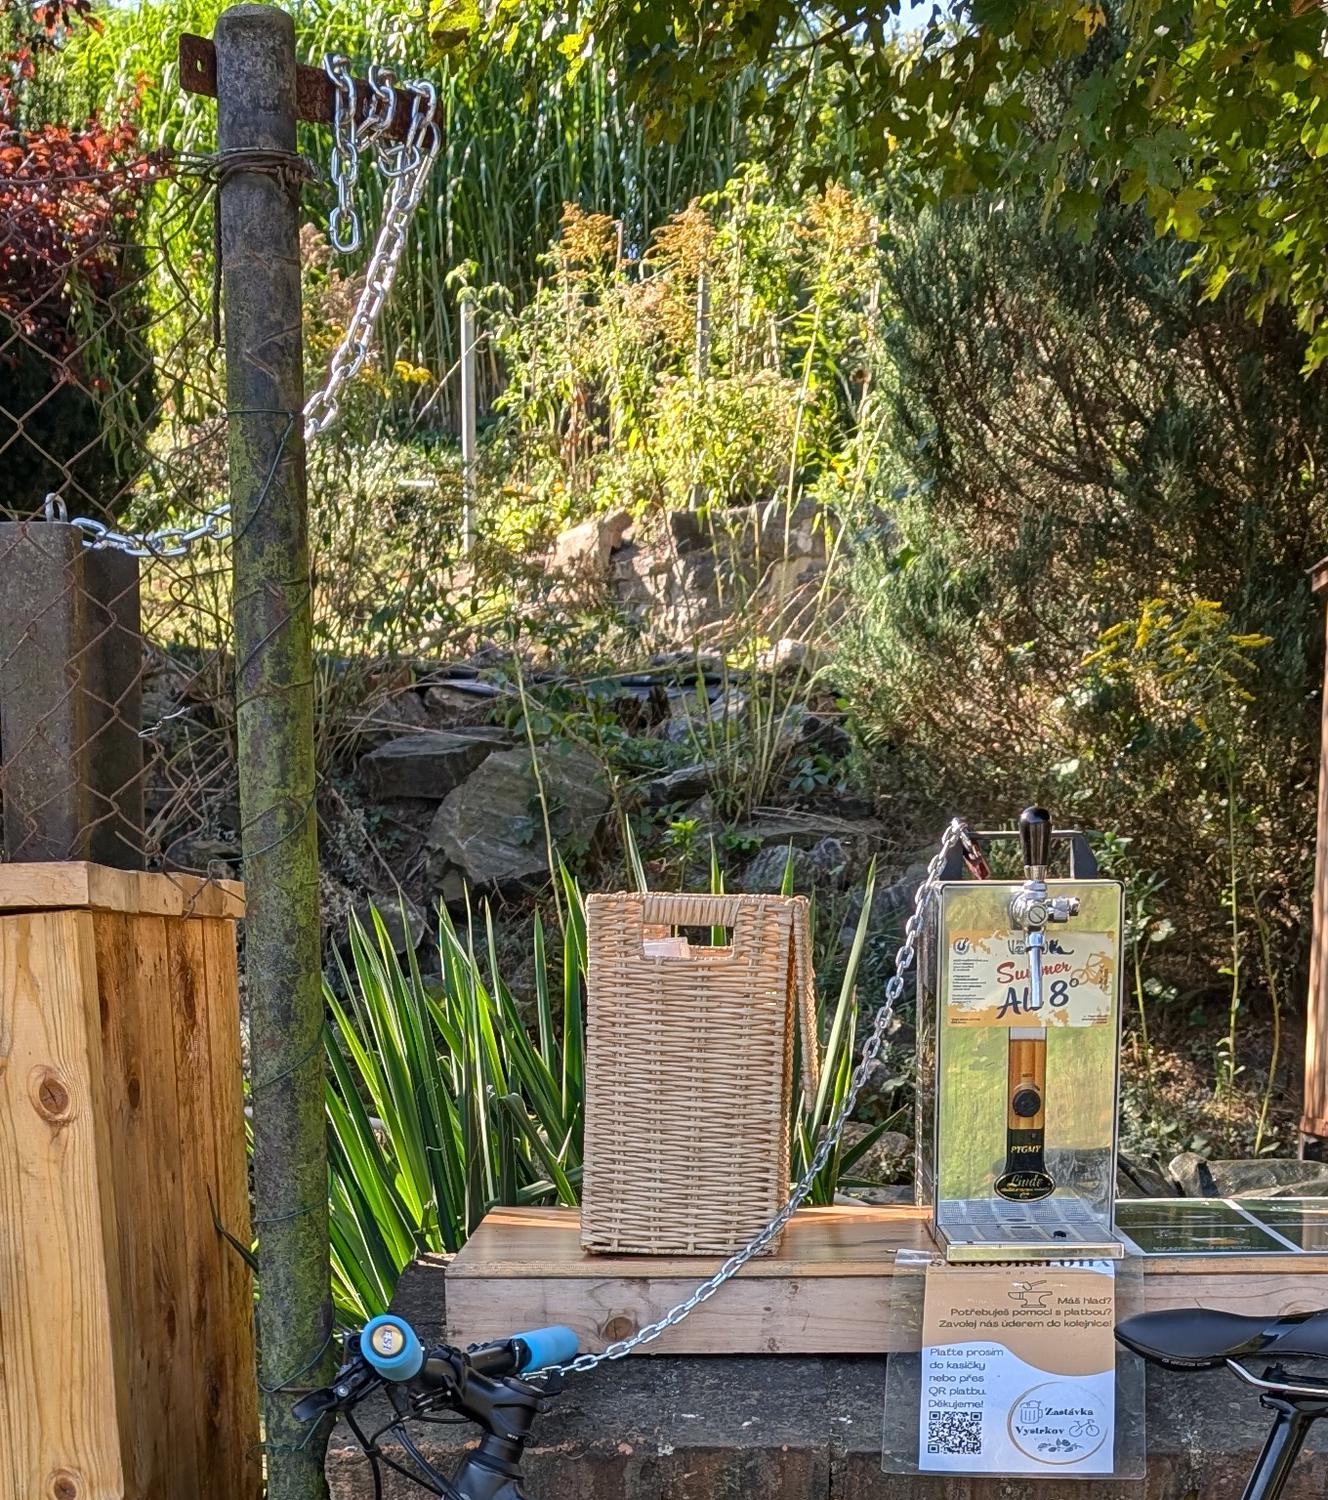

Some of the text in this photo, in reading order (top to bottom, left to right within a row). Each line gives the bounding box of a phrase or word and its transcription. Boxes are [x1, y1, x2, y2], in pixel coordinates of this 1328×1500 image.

[997, 961, 1072, 983] Sumer
[996, 986, 1044, 1019] Al
[1057, 1296, 1112, 1305] Máš hlad?
[950, 1307, 1010, 1317] Potřebuješ
[1012, 1308, 1052, 1317] pomoci
[1063, 1308, 1112, 1317] platbou?
[938, 1319, 1112, 1330] Zavolej nás úderem do kolejnice!
[929, 1347, 1004, 1358] Plaťte prosím
[929, 1360, 986, 1371] do kasičky
[928, 1373, 985, 1384] nebo přes
[928, 1386, 947, 1396] QR
[927, 1399, 984, 1410] Děkujeme!
[1044, 1406, 1094, 1417] Zastávka
[1015, 1425, 1065, 1437] Vystrkov
